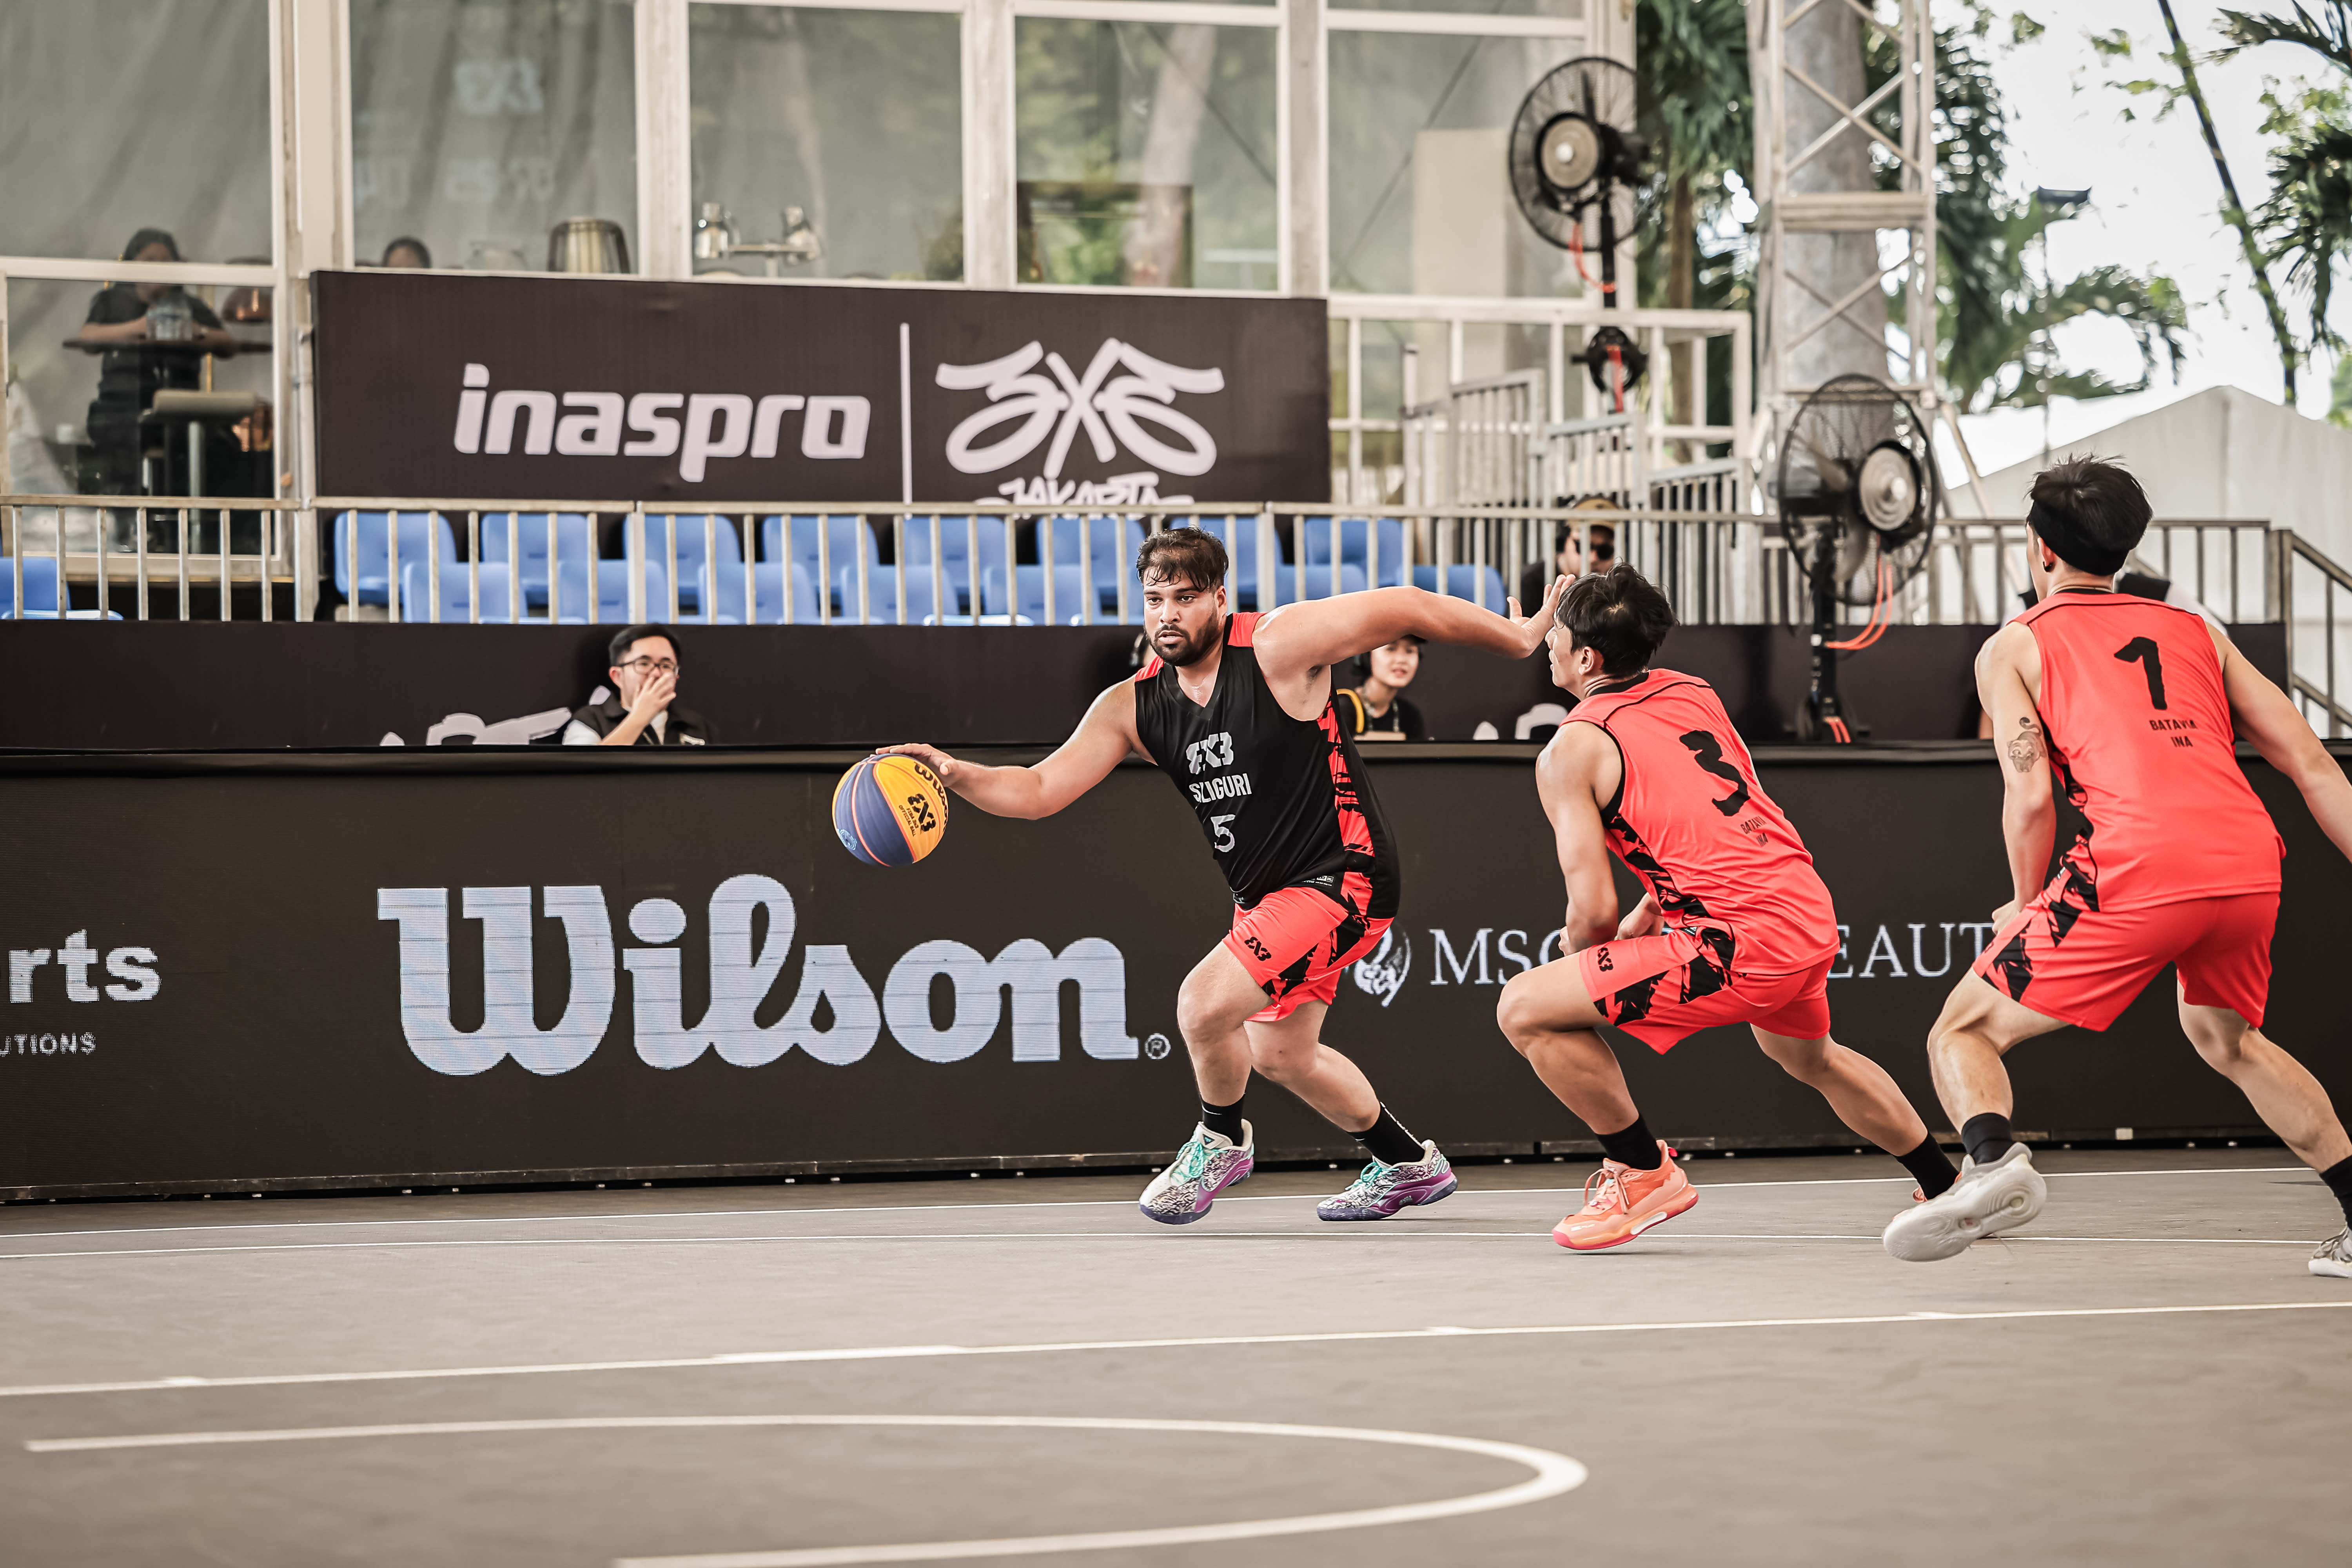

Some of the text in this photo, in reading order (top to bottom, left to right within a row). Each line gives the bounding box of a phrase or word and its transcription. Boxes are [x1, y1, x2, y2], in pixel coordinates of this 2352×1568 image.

[454, 363, 871, 483] inaspro
[2114, 637, 2167, 710] 1
[1679, 730, 1751, 817] 3
[2171, 736, 2194, 747] INA
[1210, 814, 1236, 853] 5
[8, 929, 162, 1004] rts
[377, 873, 1139, 1076] Wilson
[1826, 922, 1995, 978] EAUT
